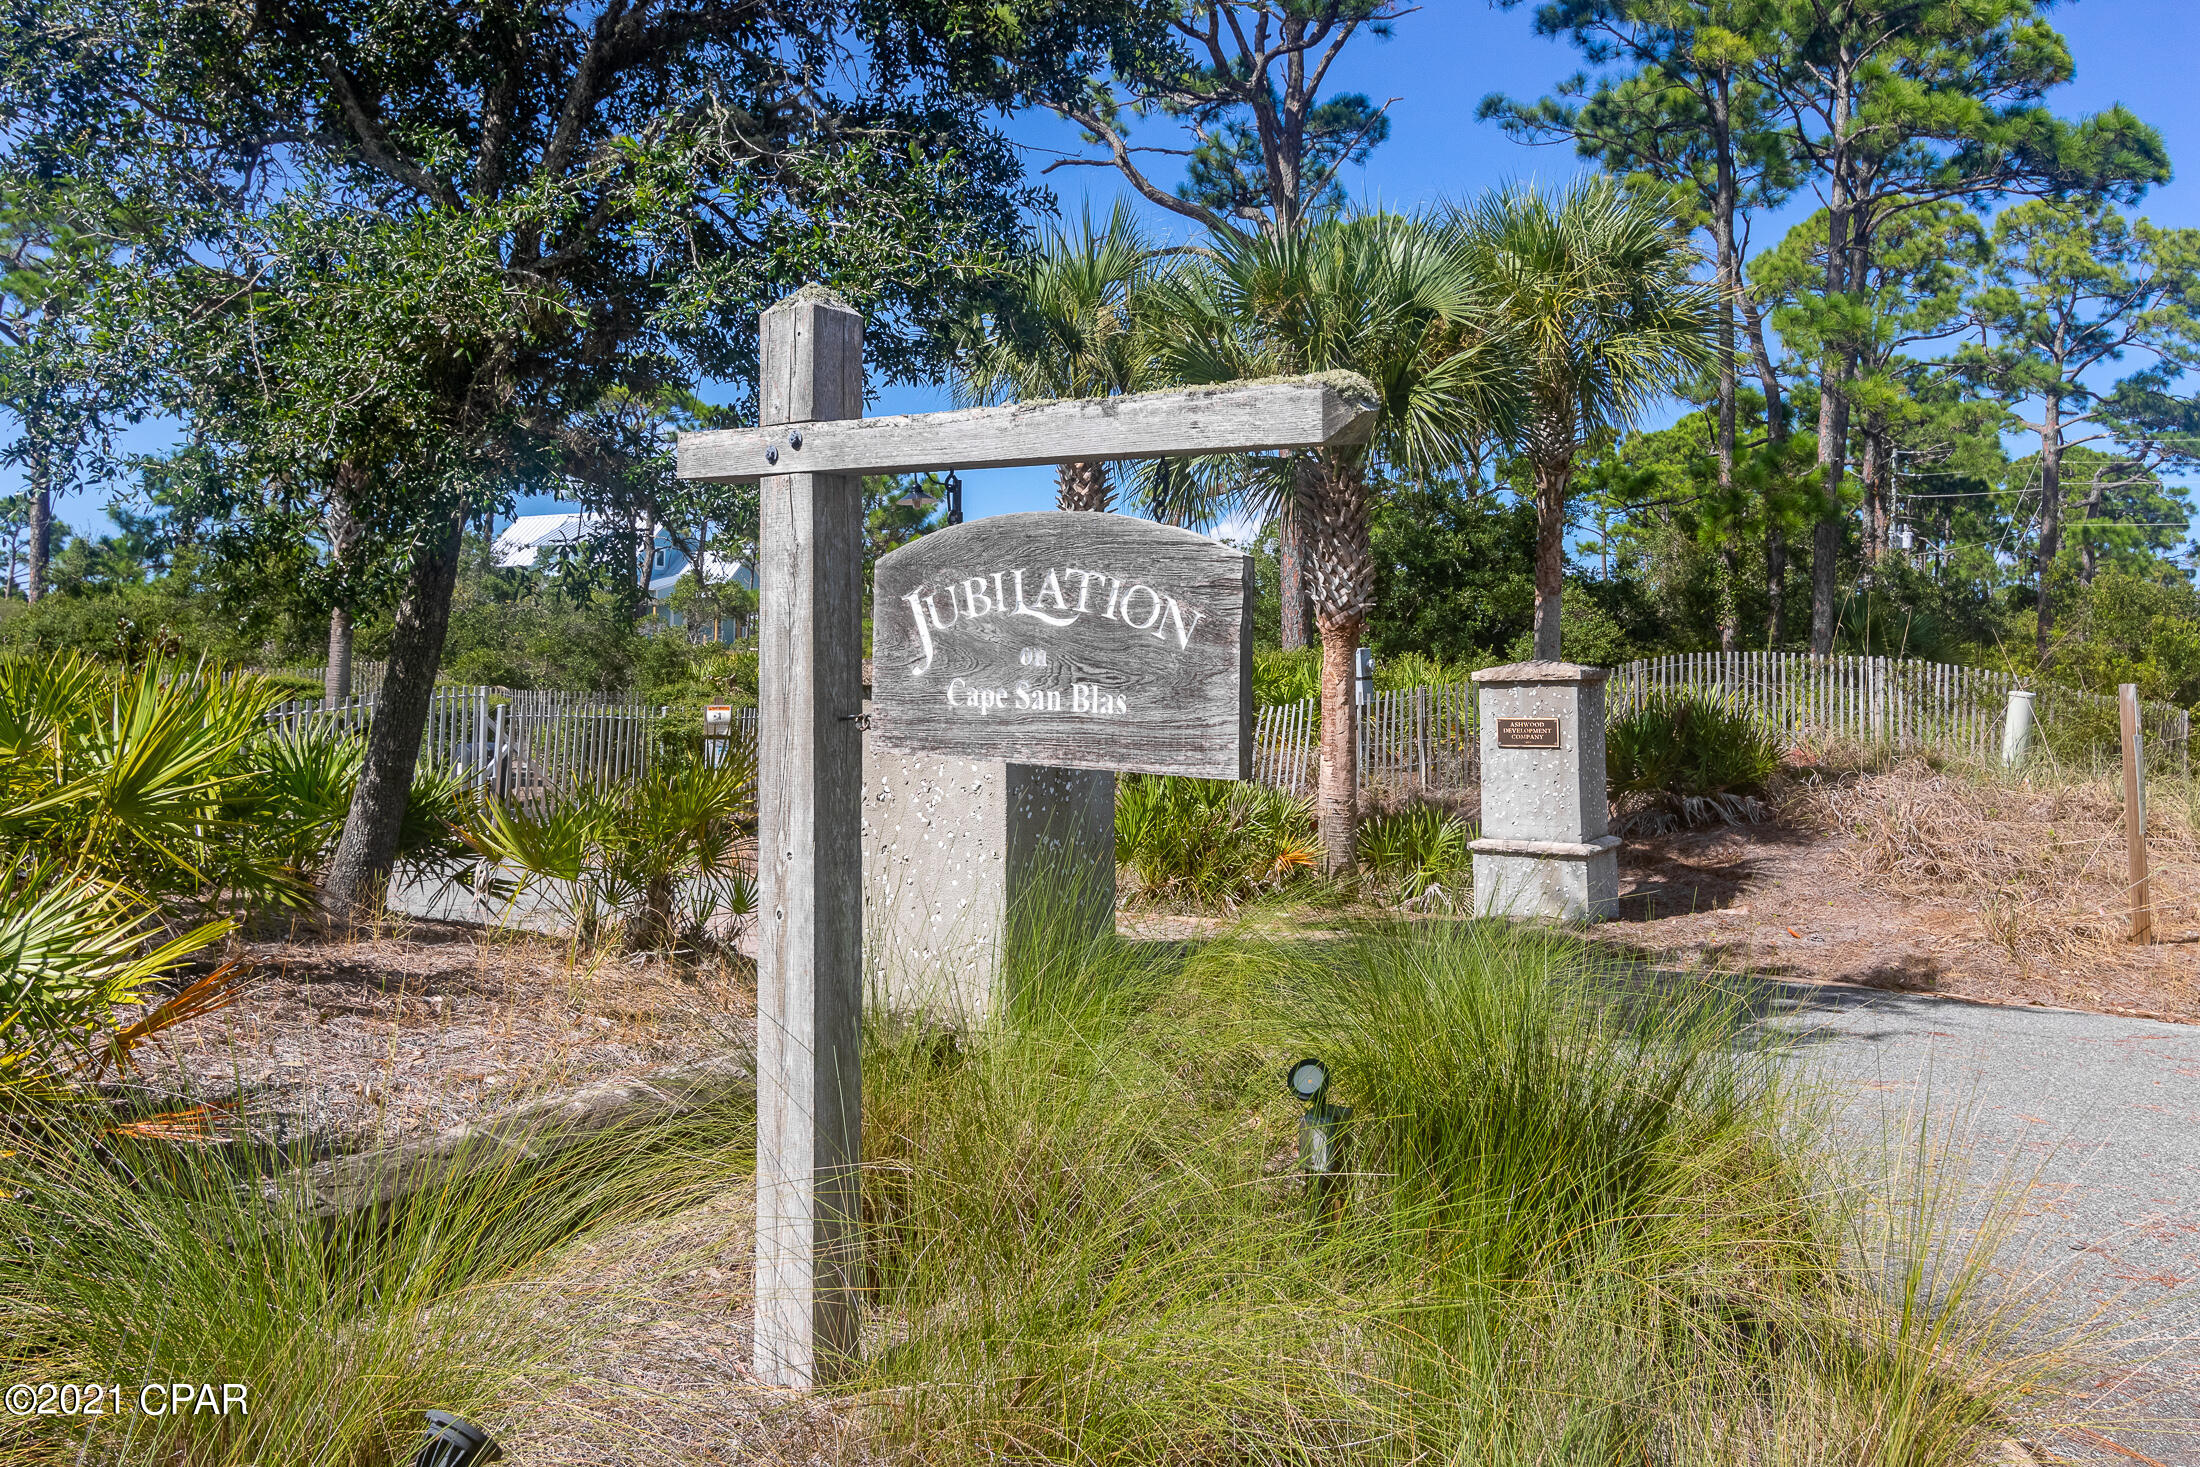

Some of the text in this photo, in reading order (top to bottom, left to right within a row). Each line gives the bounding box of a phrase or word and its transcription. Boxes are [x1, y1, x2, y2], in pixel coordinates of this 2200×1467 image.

[901, 567, 1206, 676] JUBILATION
[1019, 647, 1048, 667] on
[946, 678, 1127, 716] Cape San Blas
